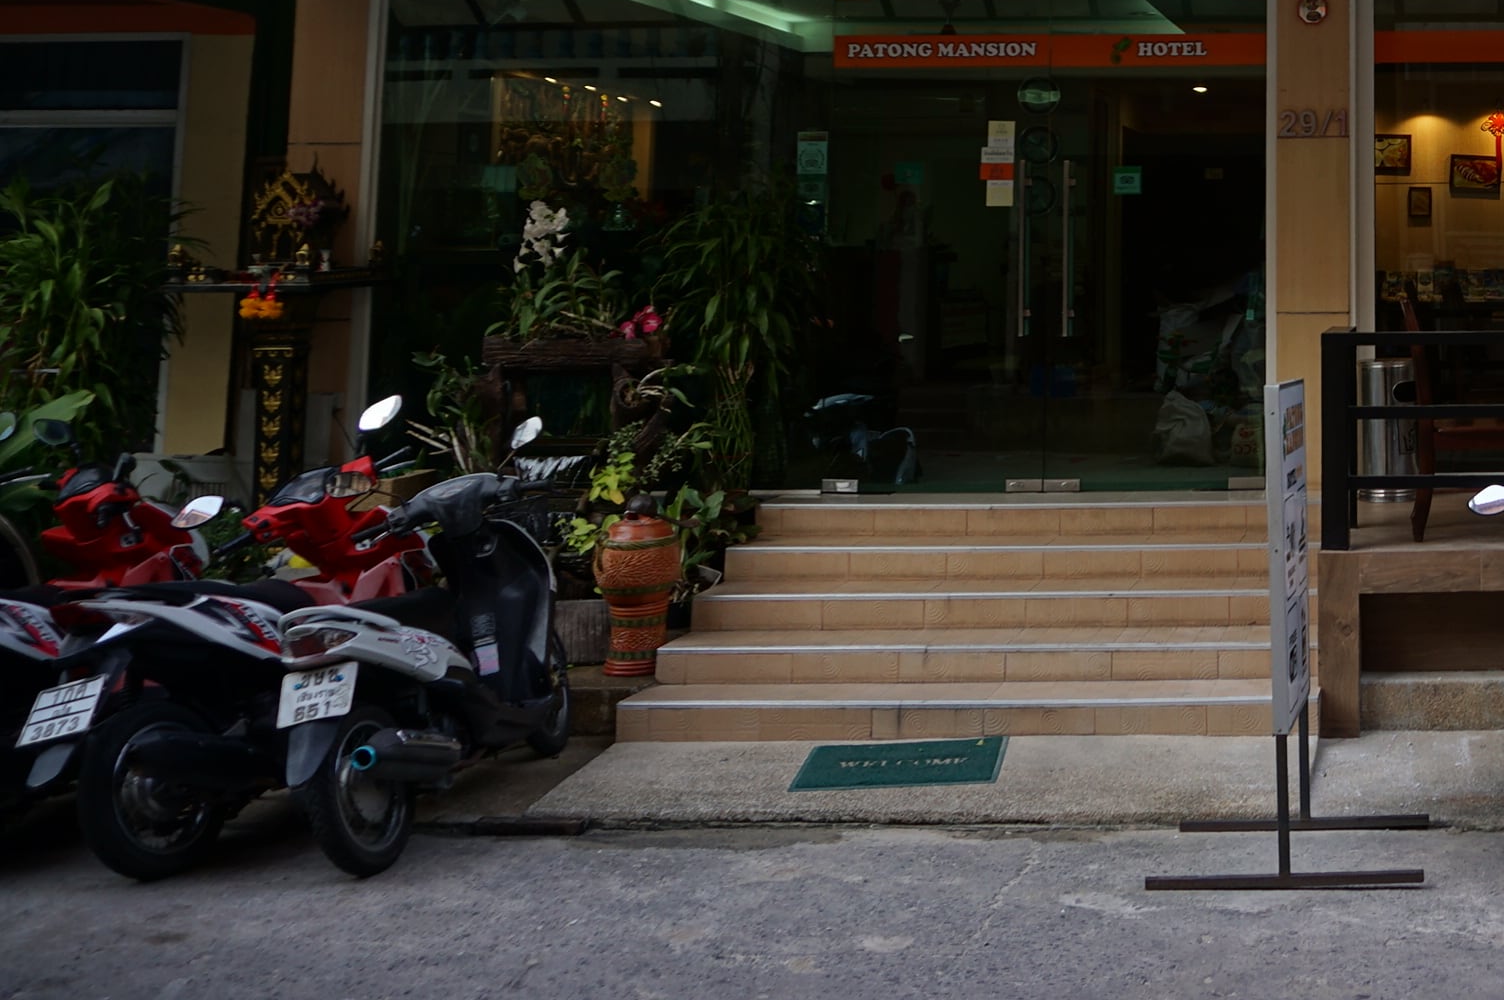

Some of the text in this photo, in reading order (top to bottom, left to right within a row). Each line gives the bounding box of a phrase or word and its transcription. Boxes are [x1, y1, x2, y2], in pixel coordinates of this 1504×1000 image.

[847, 41, 1207, 58] PATONG MANSION HOTEL
[1279, 108, 1348, 137] 29/1
[293, 700, 331, 722] 651
[30, 716, 81, 741] 3873
